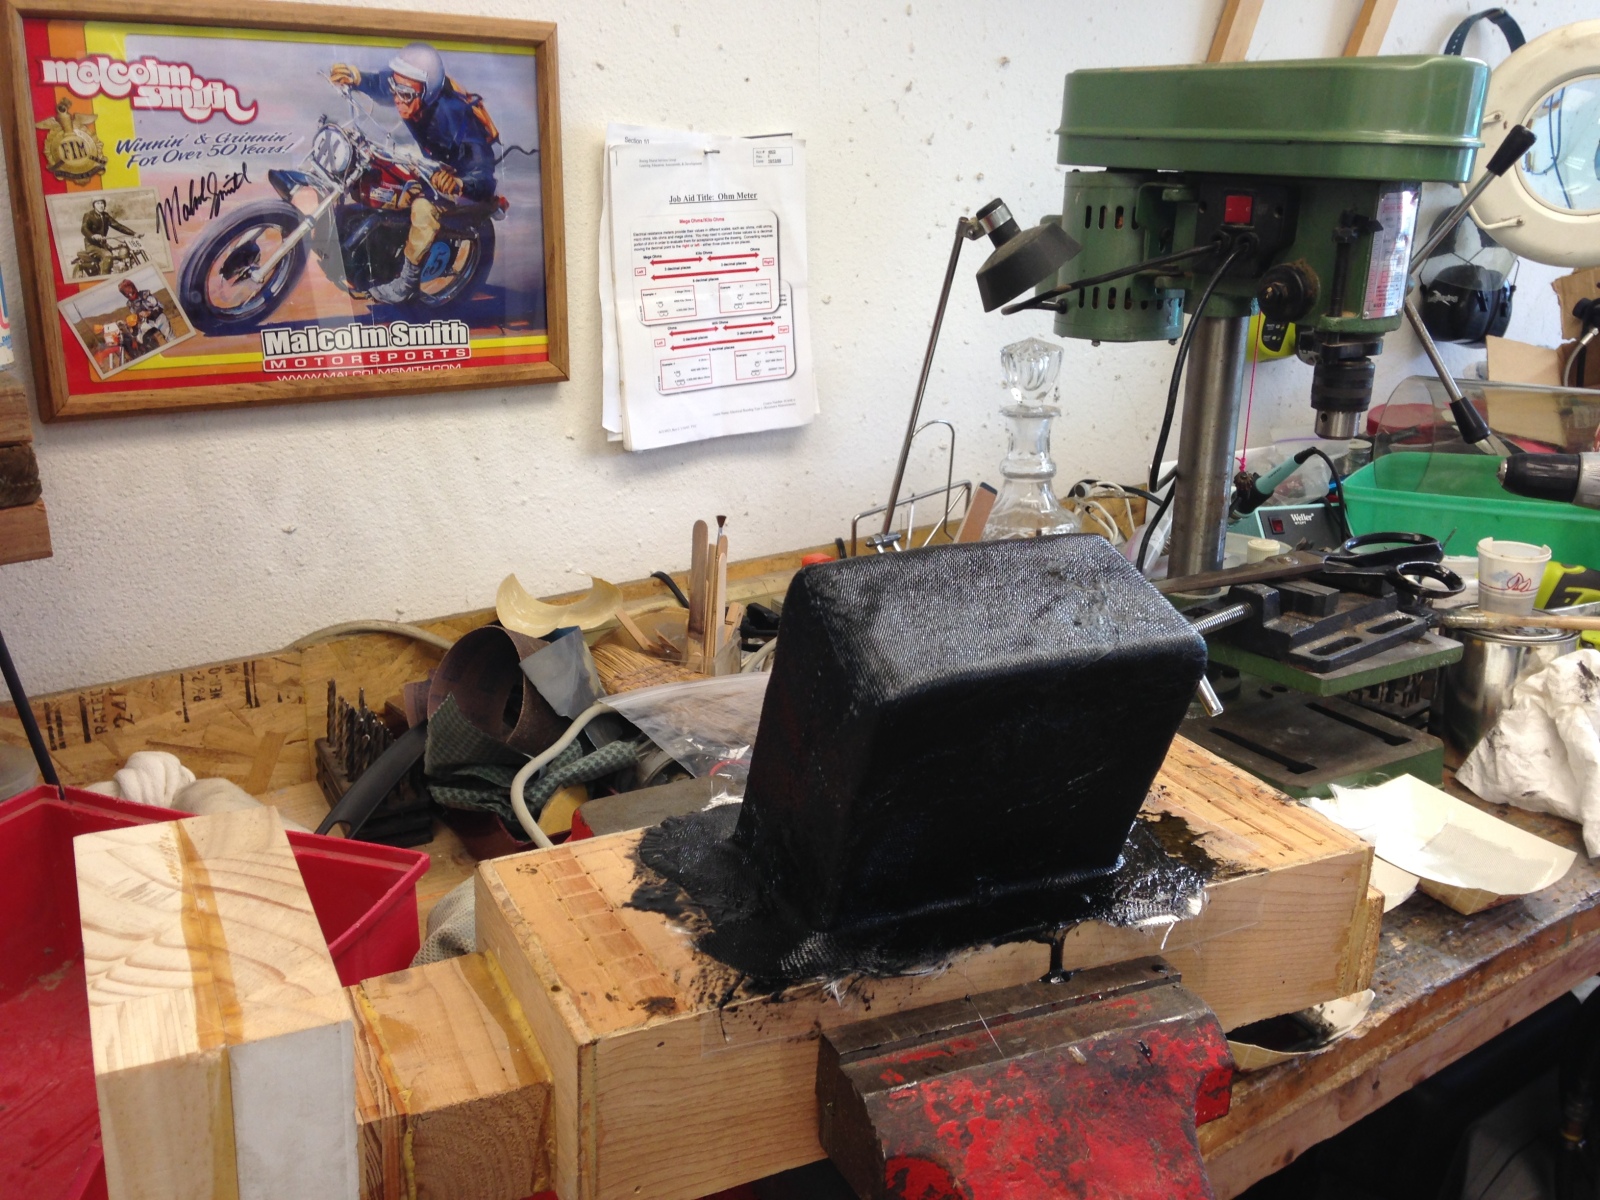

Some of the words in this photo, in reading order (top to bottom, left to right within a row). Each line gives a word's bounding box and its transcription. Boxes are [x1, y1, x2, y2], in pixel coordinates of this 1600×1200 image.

[41, 56, 192, 98] malcolm
[133, 77, 258, 123] smith
[60, 141, 88, 161] FIM
[115, 134, 188, 155] Winnin'
[194, 133, 211, 145] &
[215, 131, 293, 145] Grinnin'
[126, 153, 158, 169] For
[162, 149, 203, 164] Over
[206, 143, 238, 157] 50
[240, 142, 294, 156] Years!
[668, 195, 682, 203] Job
[683, 194, 695, 202] Aid
[696, 192, 714, 202] Title:
[717, 192, 734, 200] Ohm
[736, 192, 758, 200] Meter
[262, 323, 388, 356] Malcolm
[390, 320, 468, 347] Smith
[270, 348, 466, 369] MOTORSPORTS
[276, 364, 462, 381] WWWMACOMSMITHCOM
